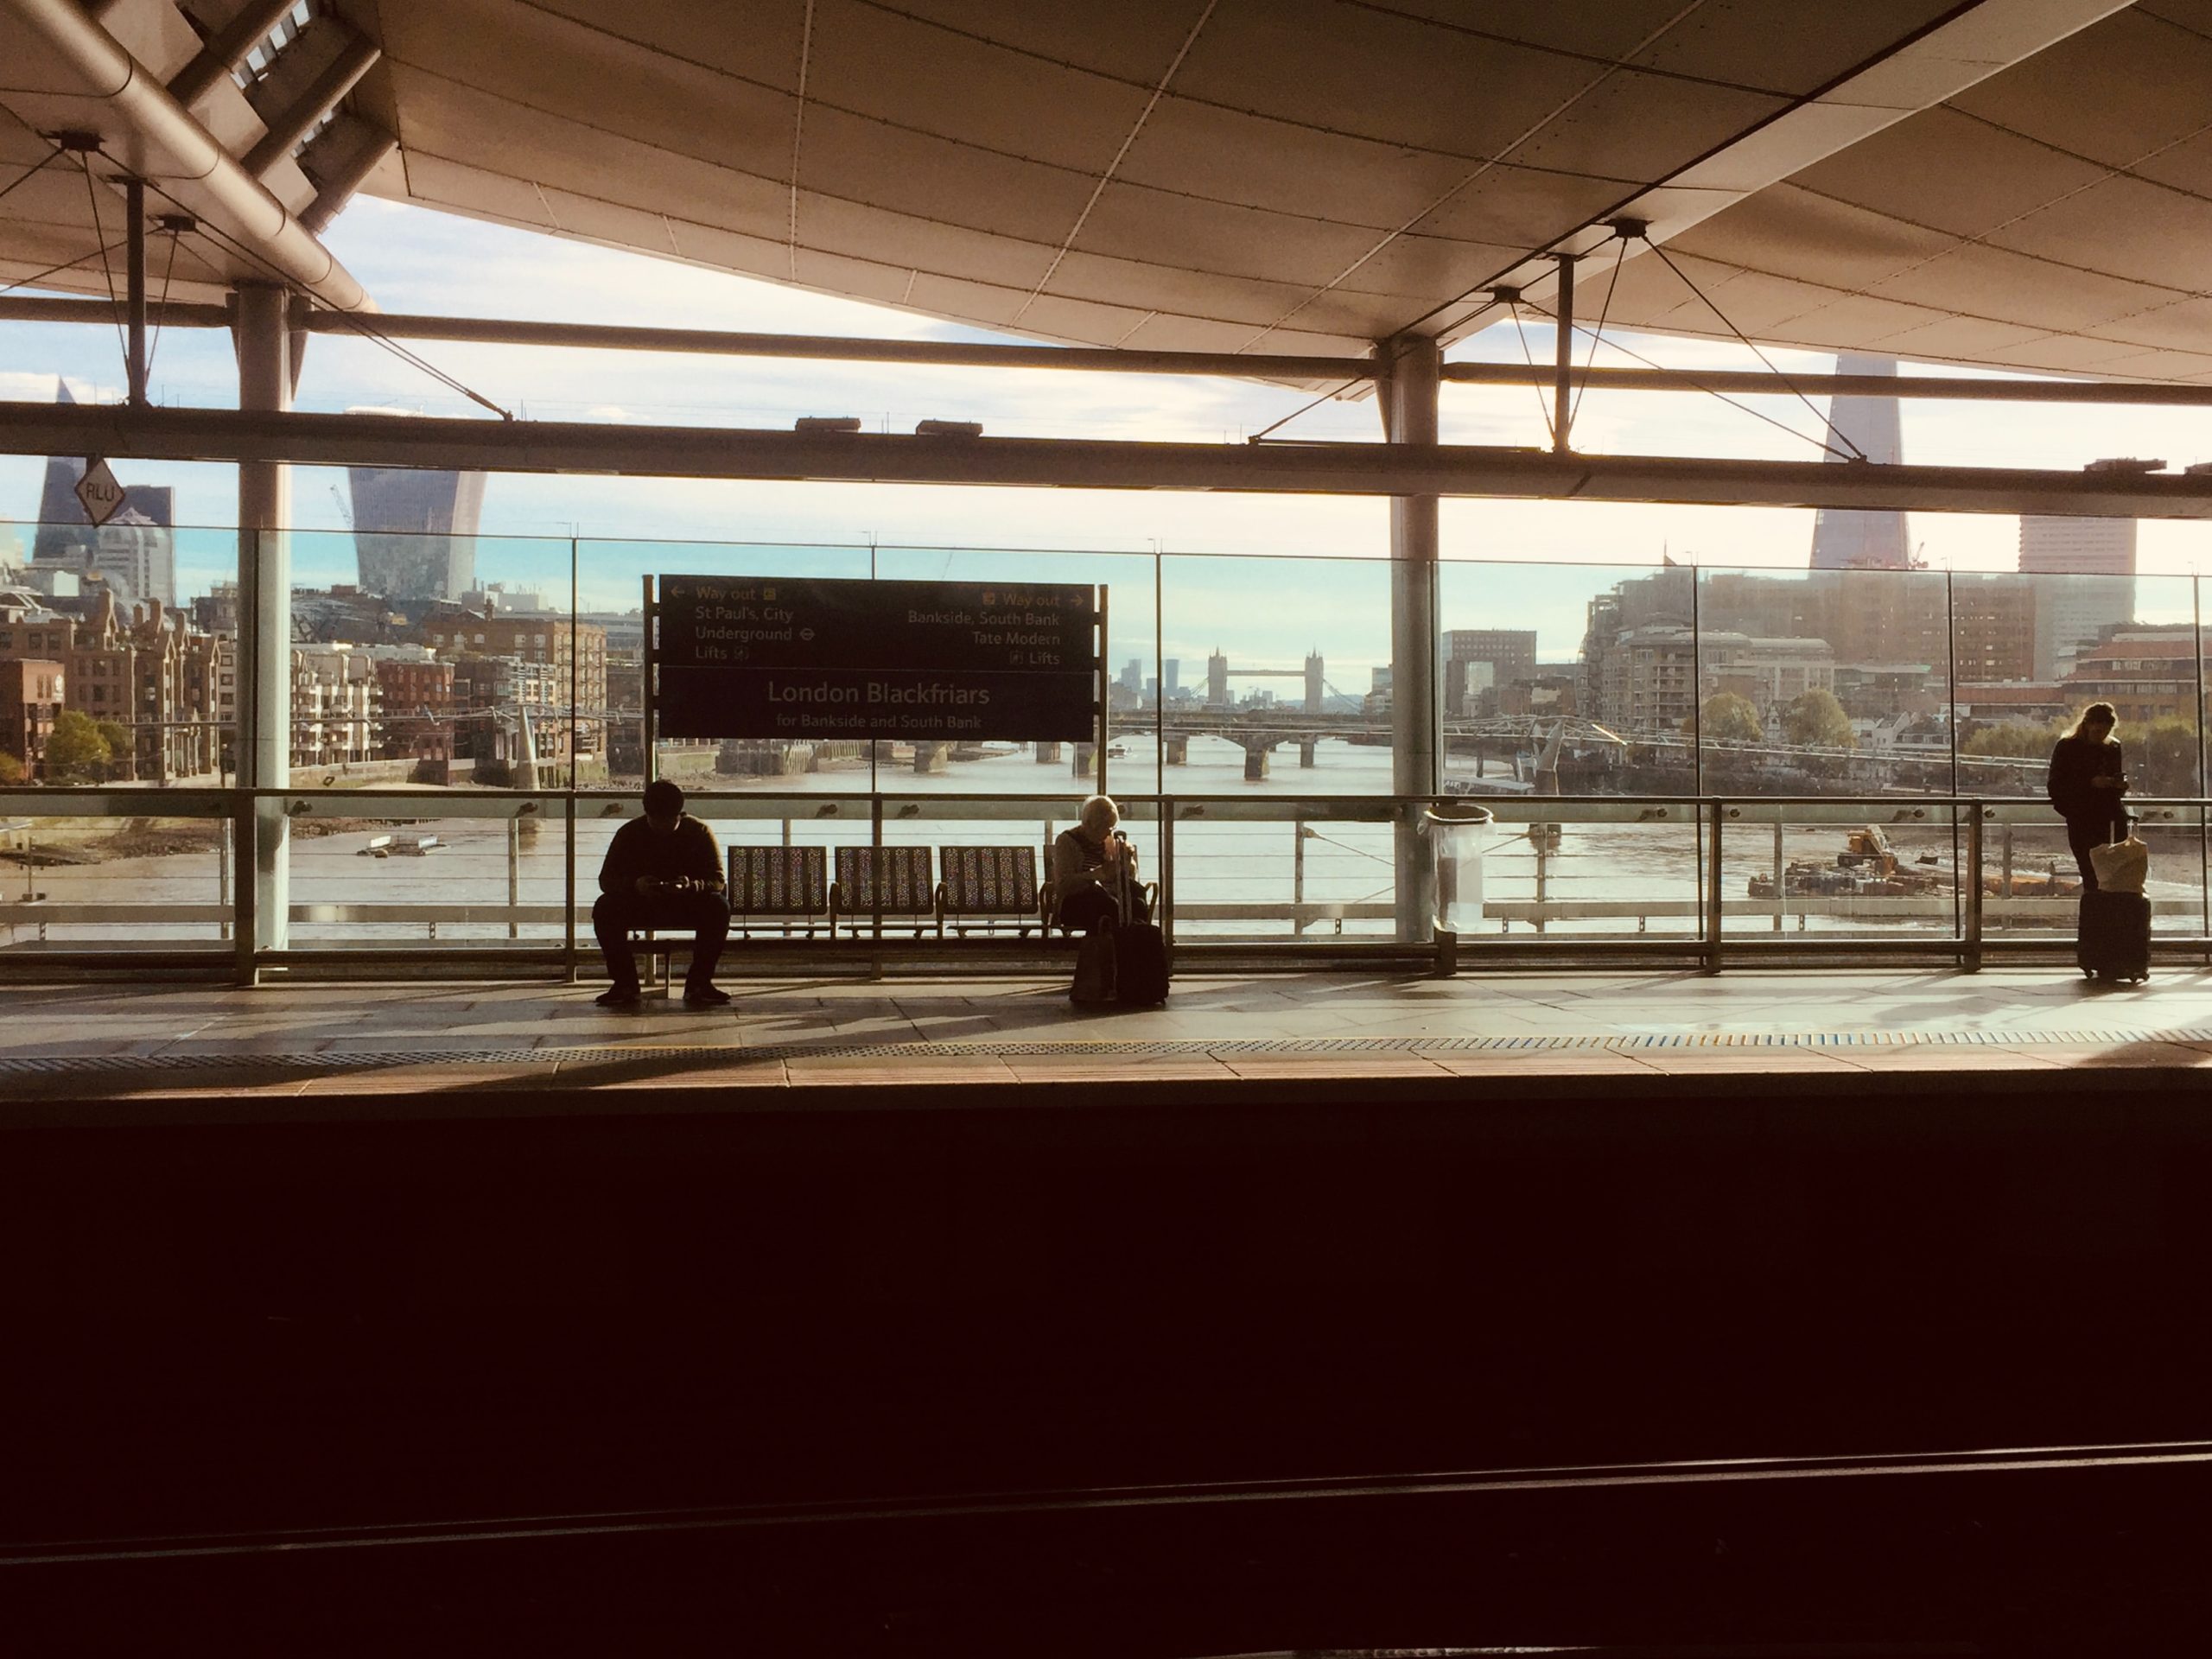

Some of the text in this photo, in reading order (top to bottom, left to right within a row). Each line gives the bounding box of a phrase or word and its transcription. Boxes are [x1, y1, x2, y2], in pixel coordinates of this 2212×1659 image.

[696, 586, 756, 602] Way out
[1003, 594, 1059, 608] Way out
[696, 607, 710, 619] St
[764, 607, 793, 623] City
[980, 612, 1020, 624] South
[1026, 613, 1058, 626] Bank
[696, 626, 791, 642] Underground
[973, 632, 1059, 645] Tate Modern
[696, 646, 727, 659] Lifts
[1030, 652, 1059, 664] Lifts
[769, 681, 989, 704] London Blackfriars
[777, 714, 981, 728] for Bankside and South Bank
